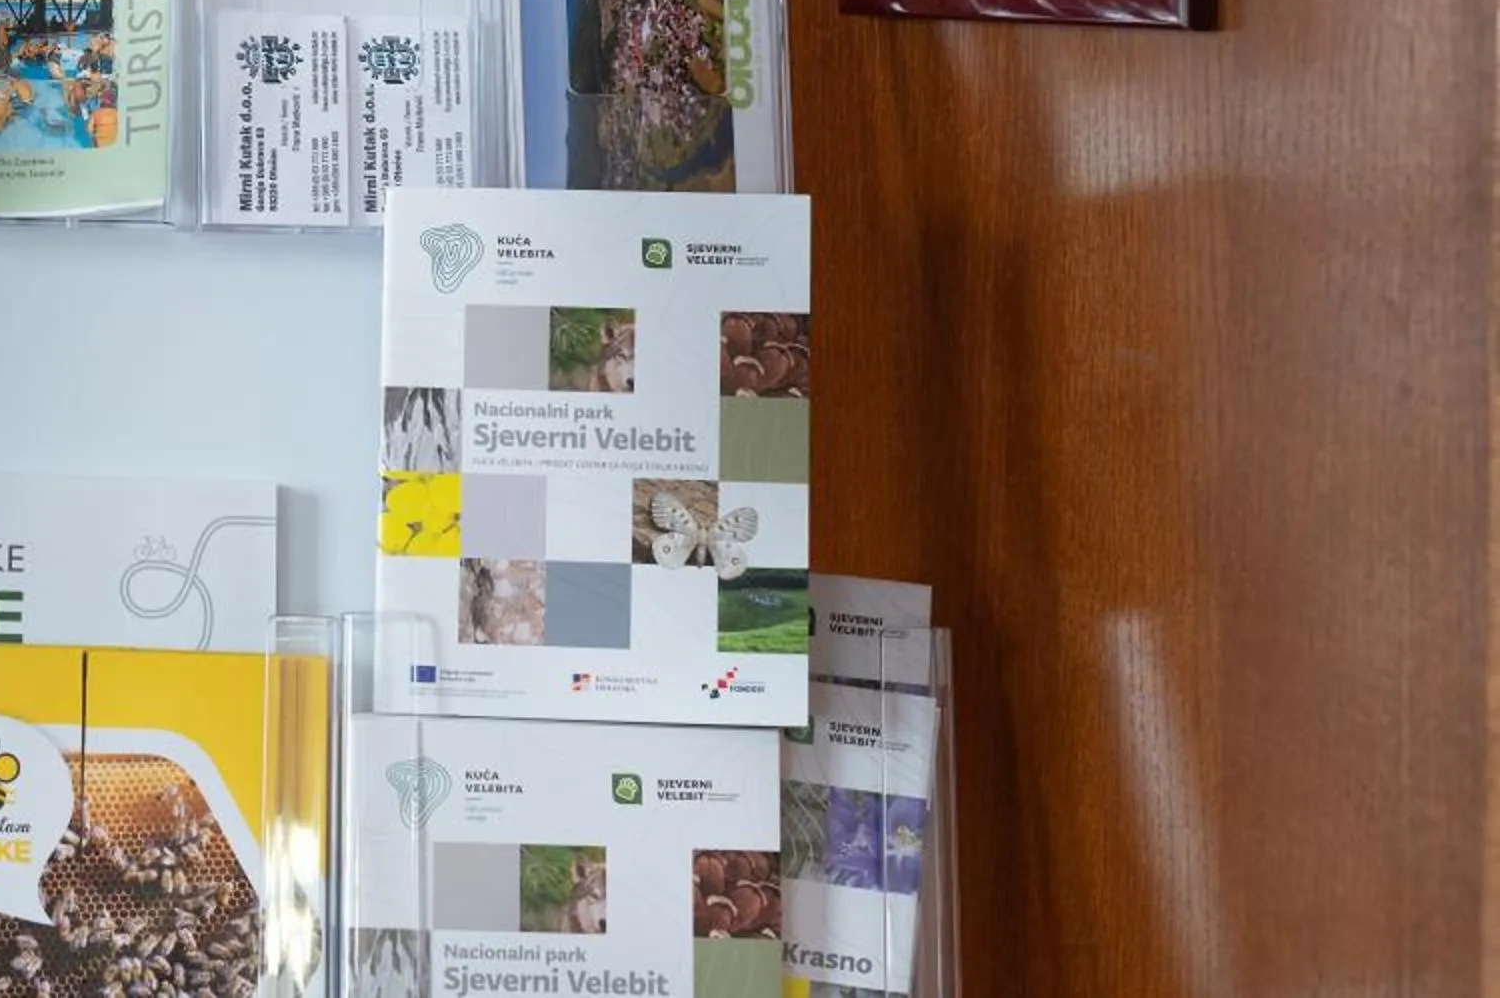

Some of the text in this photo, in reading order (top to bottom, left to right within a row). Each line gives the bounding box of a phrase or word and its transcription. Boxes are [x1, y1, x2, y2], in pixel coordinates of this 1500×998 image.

[239, 82, 252, 212] Mirni Kutak d.o.o.
[363, 127, 376, 170] Kutak
[363, 175, 377, 213] Mirni
[473, 402, 614, 423] Nacionalni park
[473, 422, 697, 453] Sjeverni Velebit
[443, 943, 588, 968] Nacionalni park
[783, 940, 874, 974] Krasno
[443, 966, 670, 997] Sjeverni Velebit
